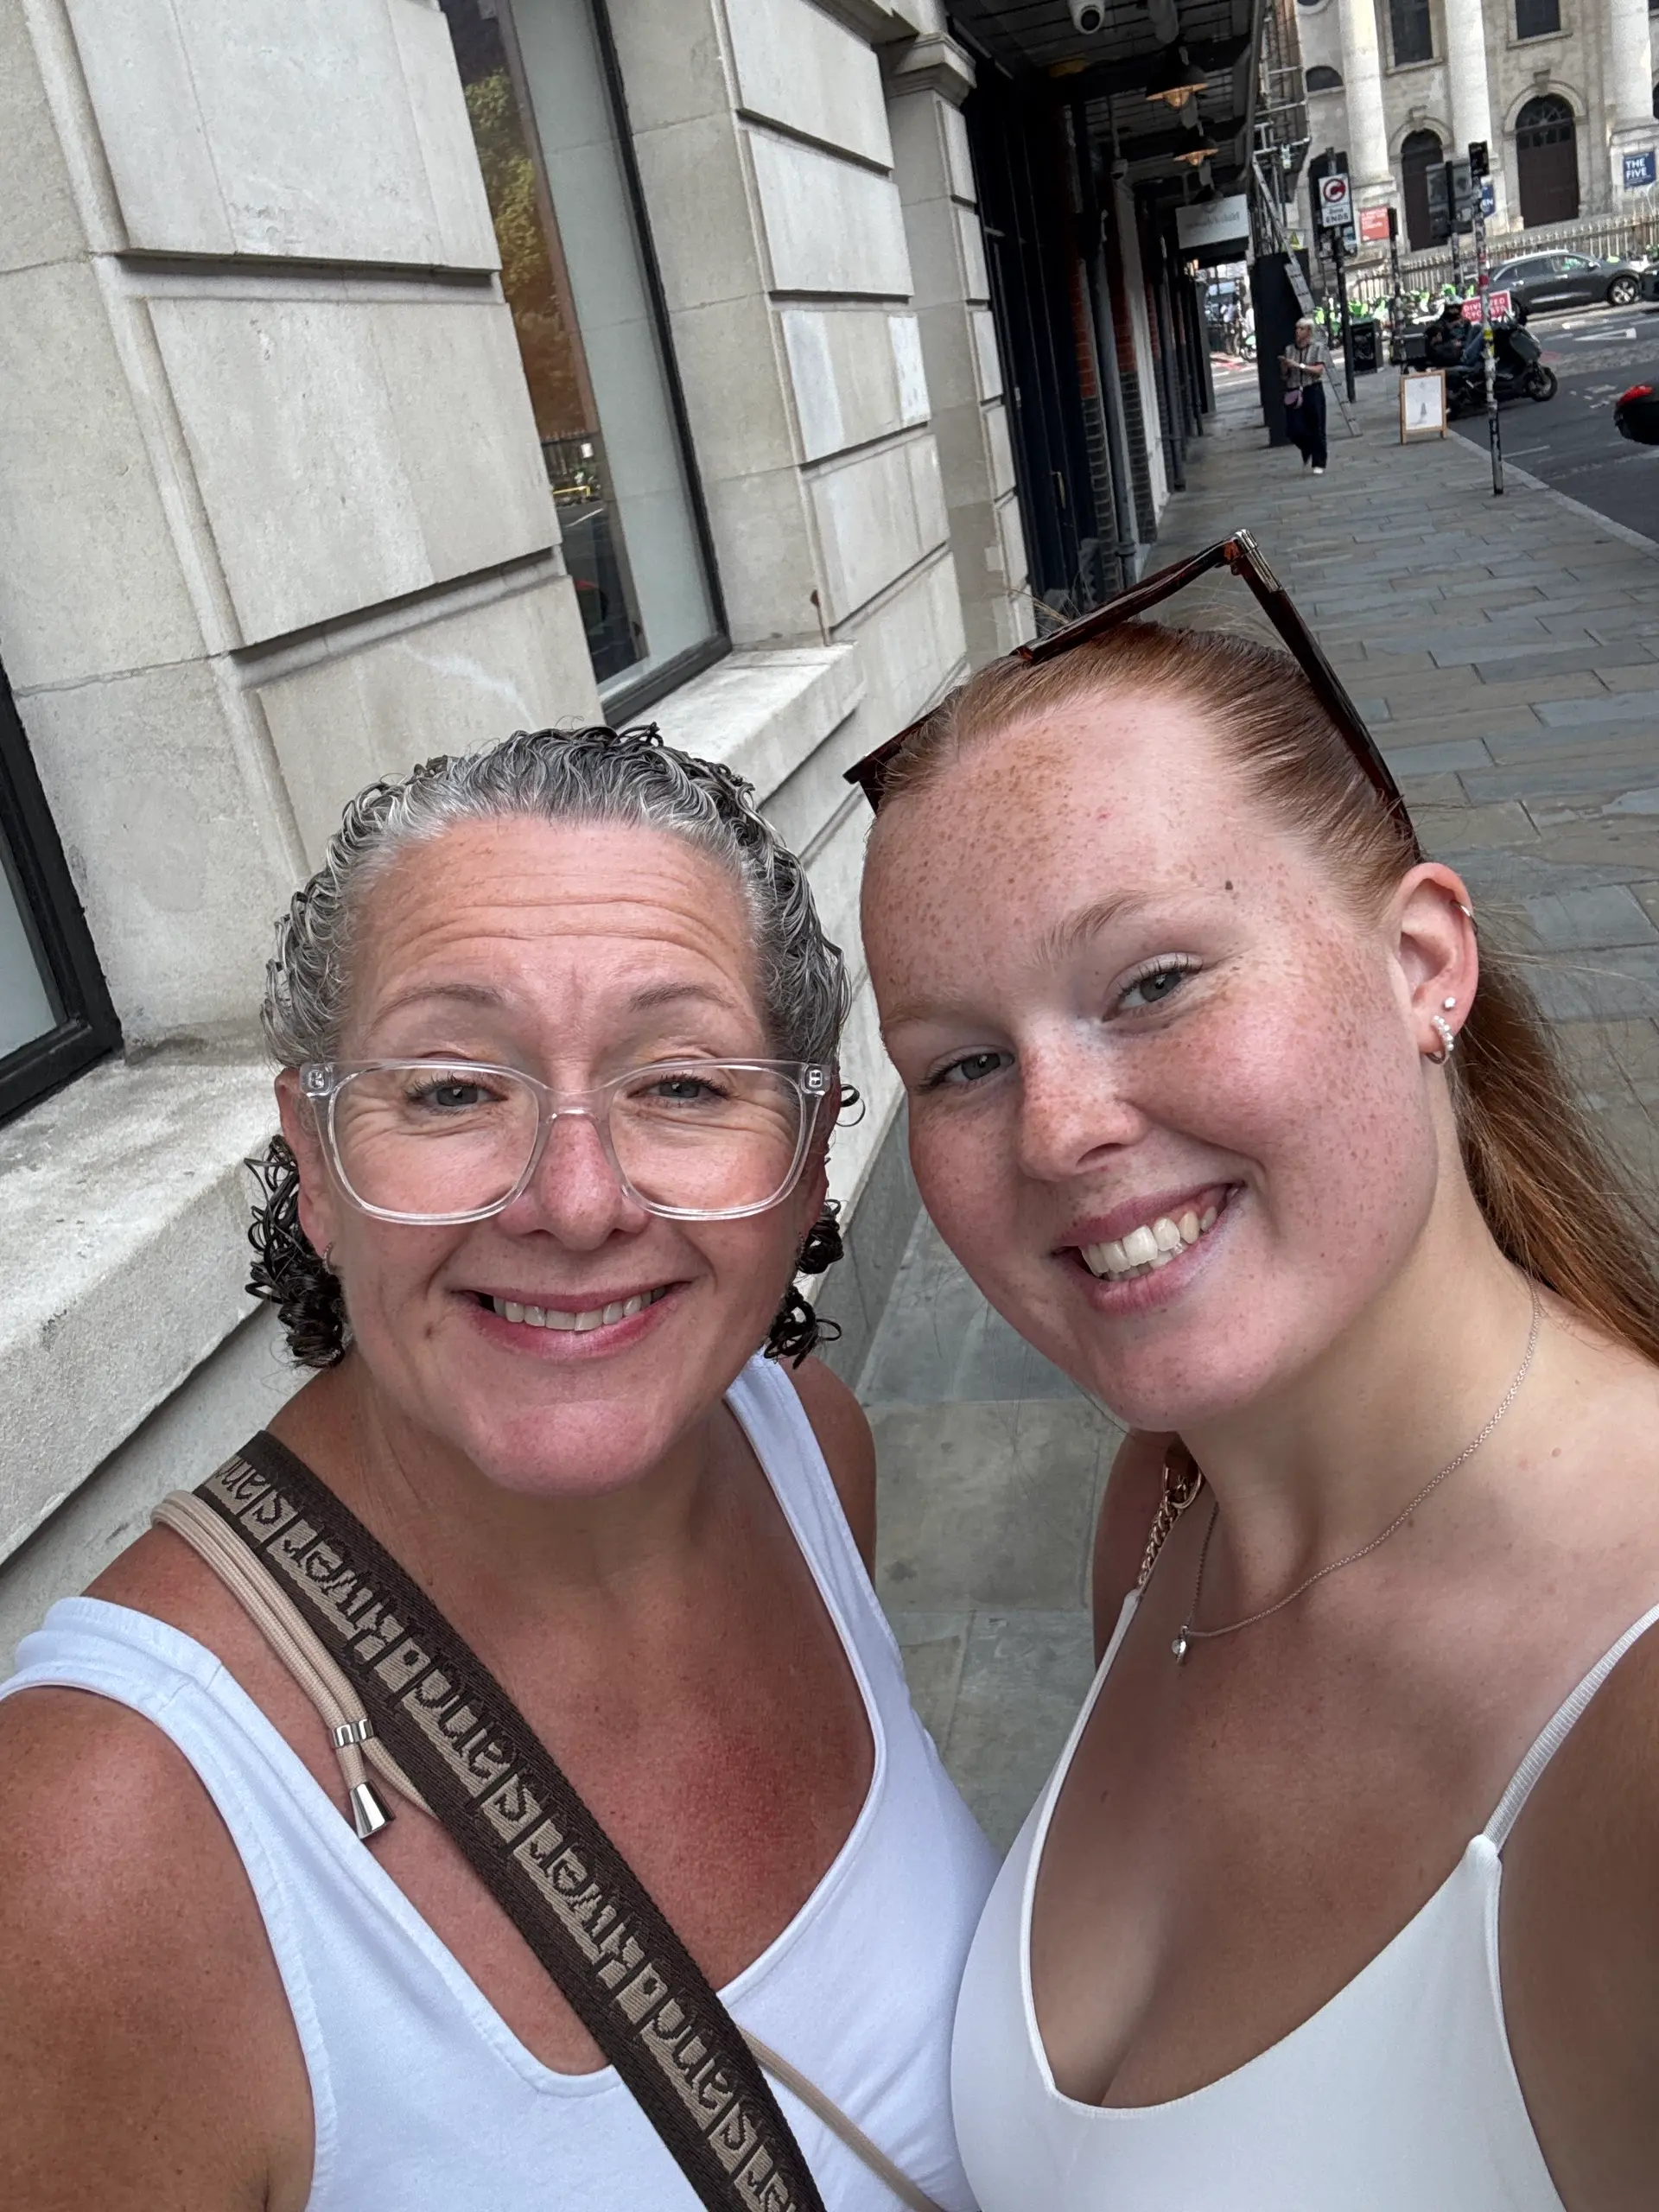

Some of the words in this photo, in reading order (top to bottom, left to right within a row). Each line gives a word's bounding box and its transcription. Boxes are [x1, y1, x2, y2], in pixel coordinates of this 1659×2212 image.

[1325, 213, 1349, 224] ENDS
[1625, 158, 1645, 169] THE
[1626, 167, 1647, 180] FIVE
[213, 1457, 306, 1558] Islan
[283, 1519, 423, 1681] River
[385, 1647, 560, 1858] Island
[528, 1823, 681, 2006] River
[624, 1986, 772, 2177] Island
